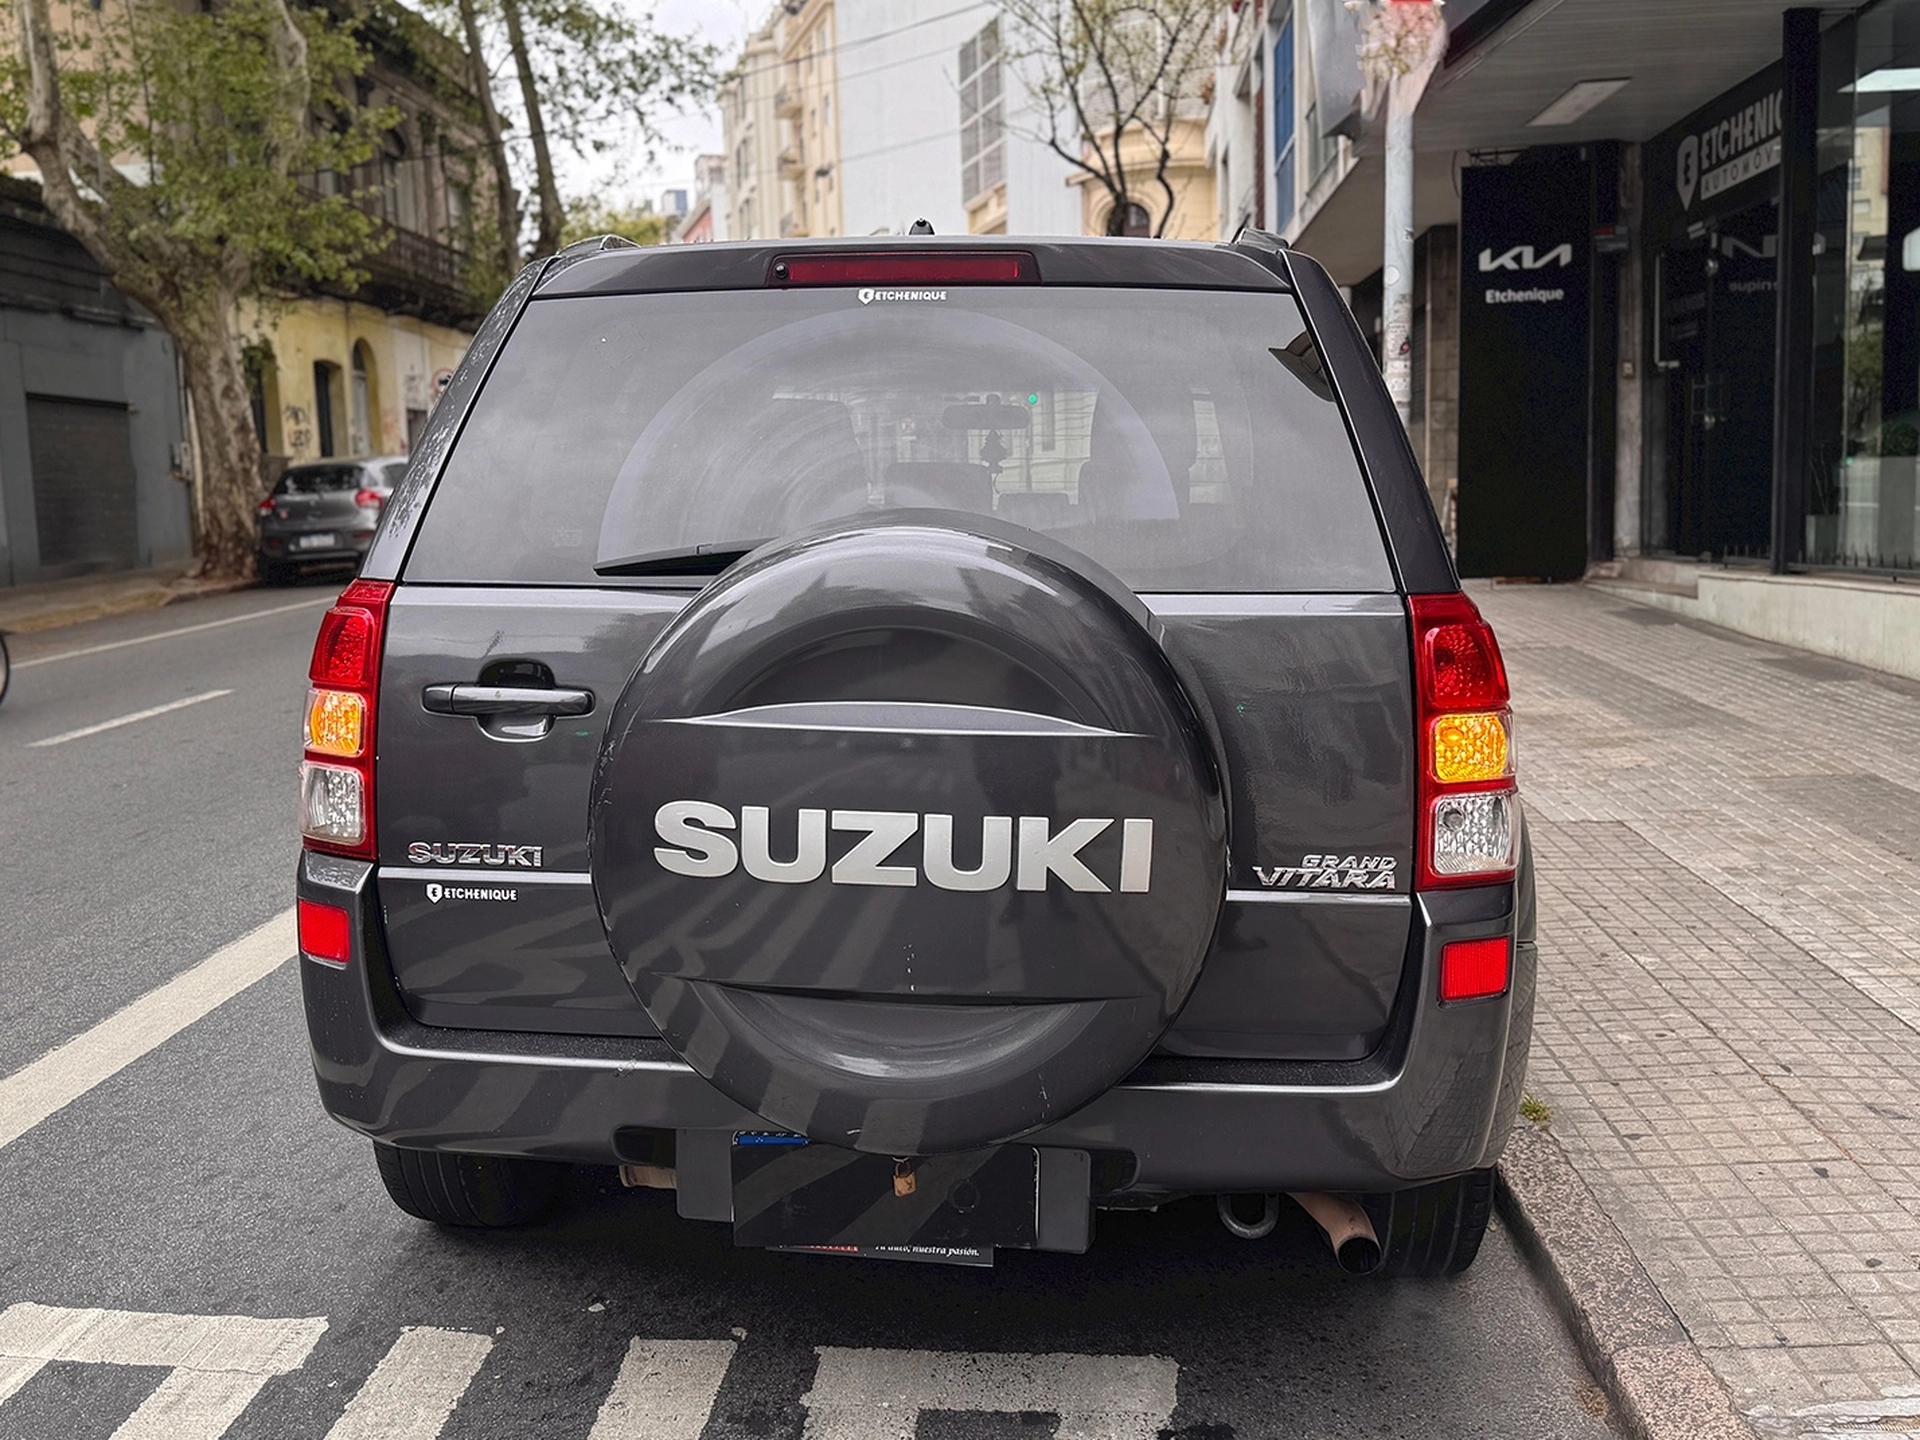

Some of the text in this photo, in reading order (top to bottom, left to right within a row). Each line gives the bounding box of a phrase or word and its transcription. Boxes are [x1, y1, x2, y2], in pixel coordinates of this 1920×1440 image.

[1479, 244, 1572, 272] KIA
[875, 291, 947, 301] ETCHENIQUE
[1485, 287, 1564, 304] Etchenique
[407, 842, 543, 867] SUZUKI
[654, 800, 1154, 893] SUZUKI
[1302, 855, 1397, 870] GRAND
[1252, 866, 1397, 890] VITARA
[444, 888, 517, 900] ETCHENIQUE
[912, 1246, 947, 1254] nuestra
[945, 1247, 980, 1258] pasión.
